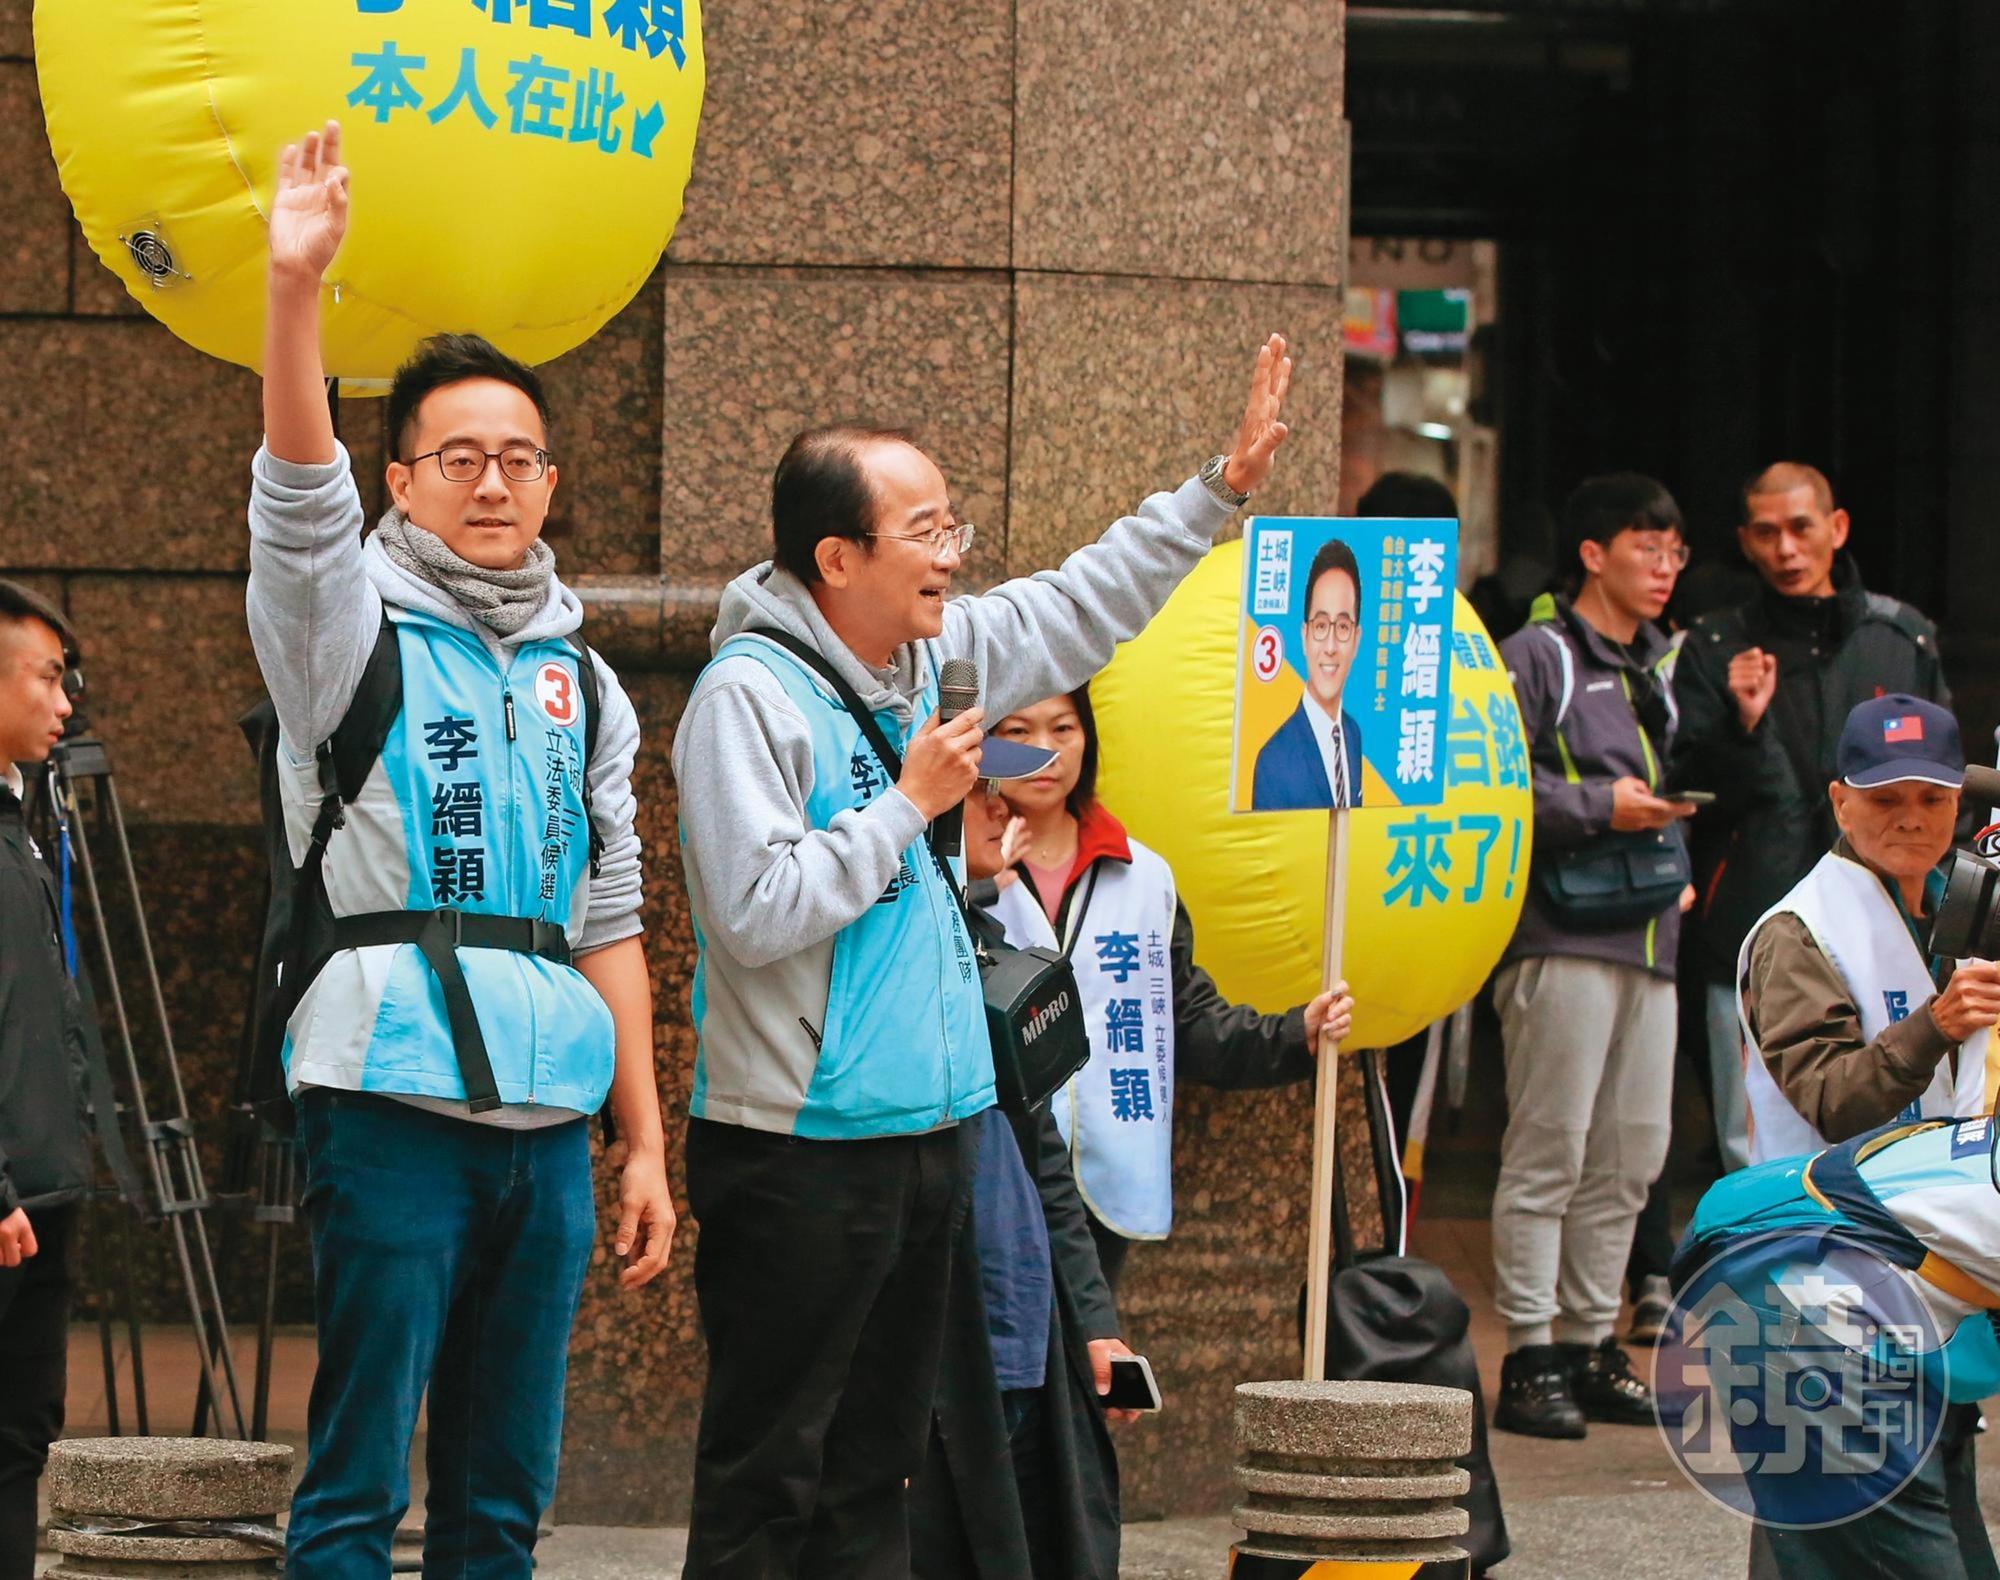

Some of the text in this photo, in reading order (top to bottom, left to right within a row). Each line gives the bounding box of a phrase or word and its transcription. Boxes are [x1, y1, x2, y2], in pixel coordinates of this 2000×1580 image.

[346, 41, 625, 155] 本人在此
[1258, 569, 1287, 593] 三峽
[1260, 537, 1289, 561] 土城
[544, 668, 572, 721] 3
[1258, 635, 1277, 674] 3
[1396, 538, 1445, 785] 李縉穎
[423, 715, 485, 904] 李縉穎
[534, 728, 566, 926] 立法委員候選人
[1382, 813, 1521, 908] 來了!
[1094, 930, 1155, 1123] 李縉穎
